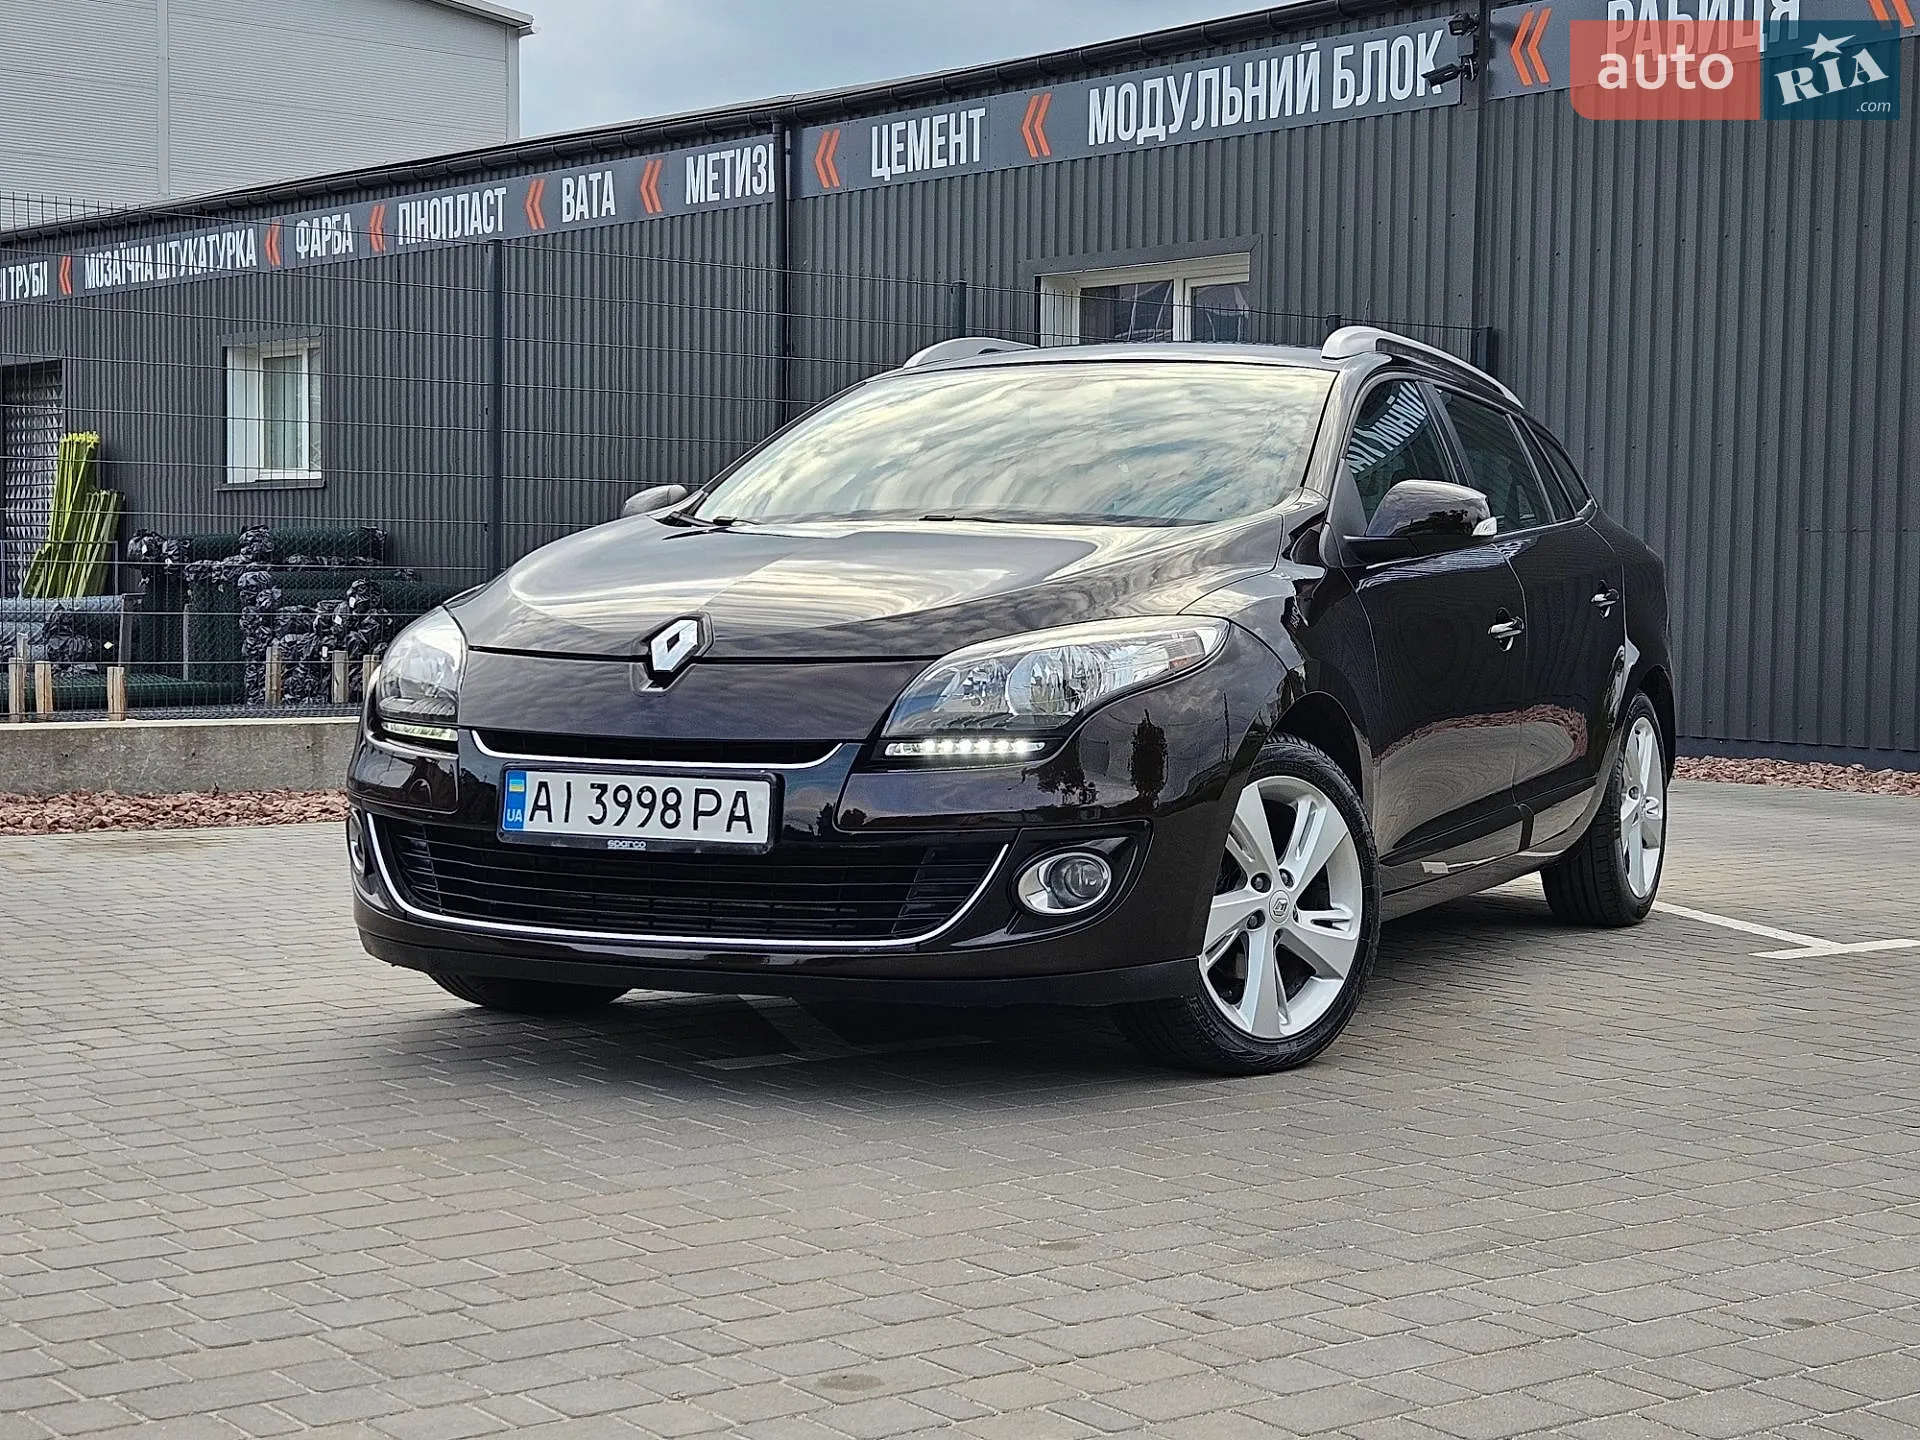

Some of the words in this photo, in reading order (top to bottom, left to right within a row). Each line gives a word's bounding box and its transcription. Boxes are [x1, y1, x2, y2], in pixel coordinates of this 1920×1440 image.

[1088, 42, 1321, 146] МОДУЛЬНИЙ
[1332, 29, 1444, 110] БЛОК
[871, 107, 986, 182] ЦЕМЕНТ
[398, 187, 507, 246] ПІНОПЛАСТ
[561, 170, 616, 223] ВАТА
[84, 242, 154, 290] МОЗАЇЧНА
[156, 228, 257, 280] ШТУКАТУРКА
[295, 212, 354, 260] ФАРБА
[8, 261, 48, 300] ТРУБИ
[506, 808, 523, 823] UA
[607, 840, 647, 850] sparco
